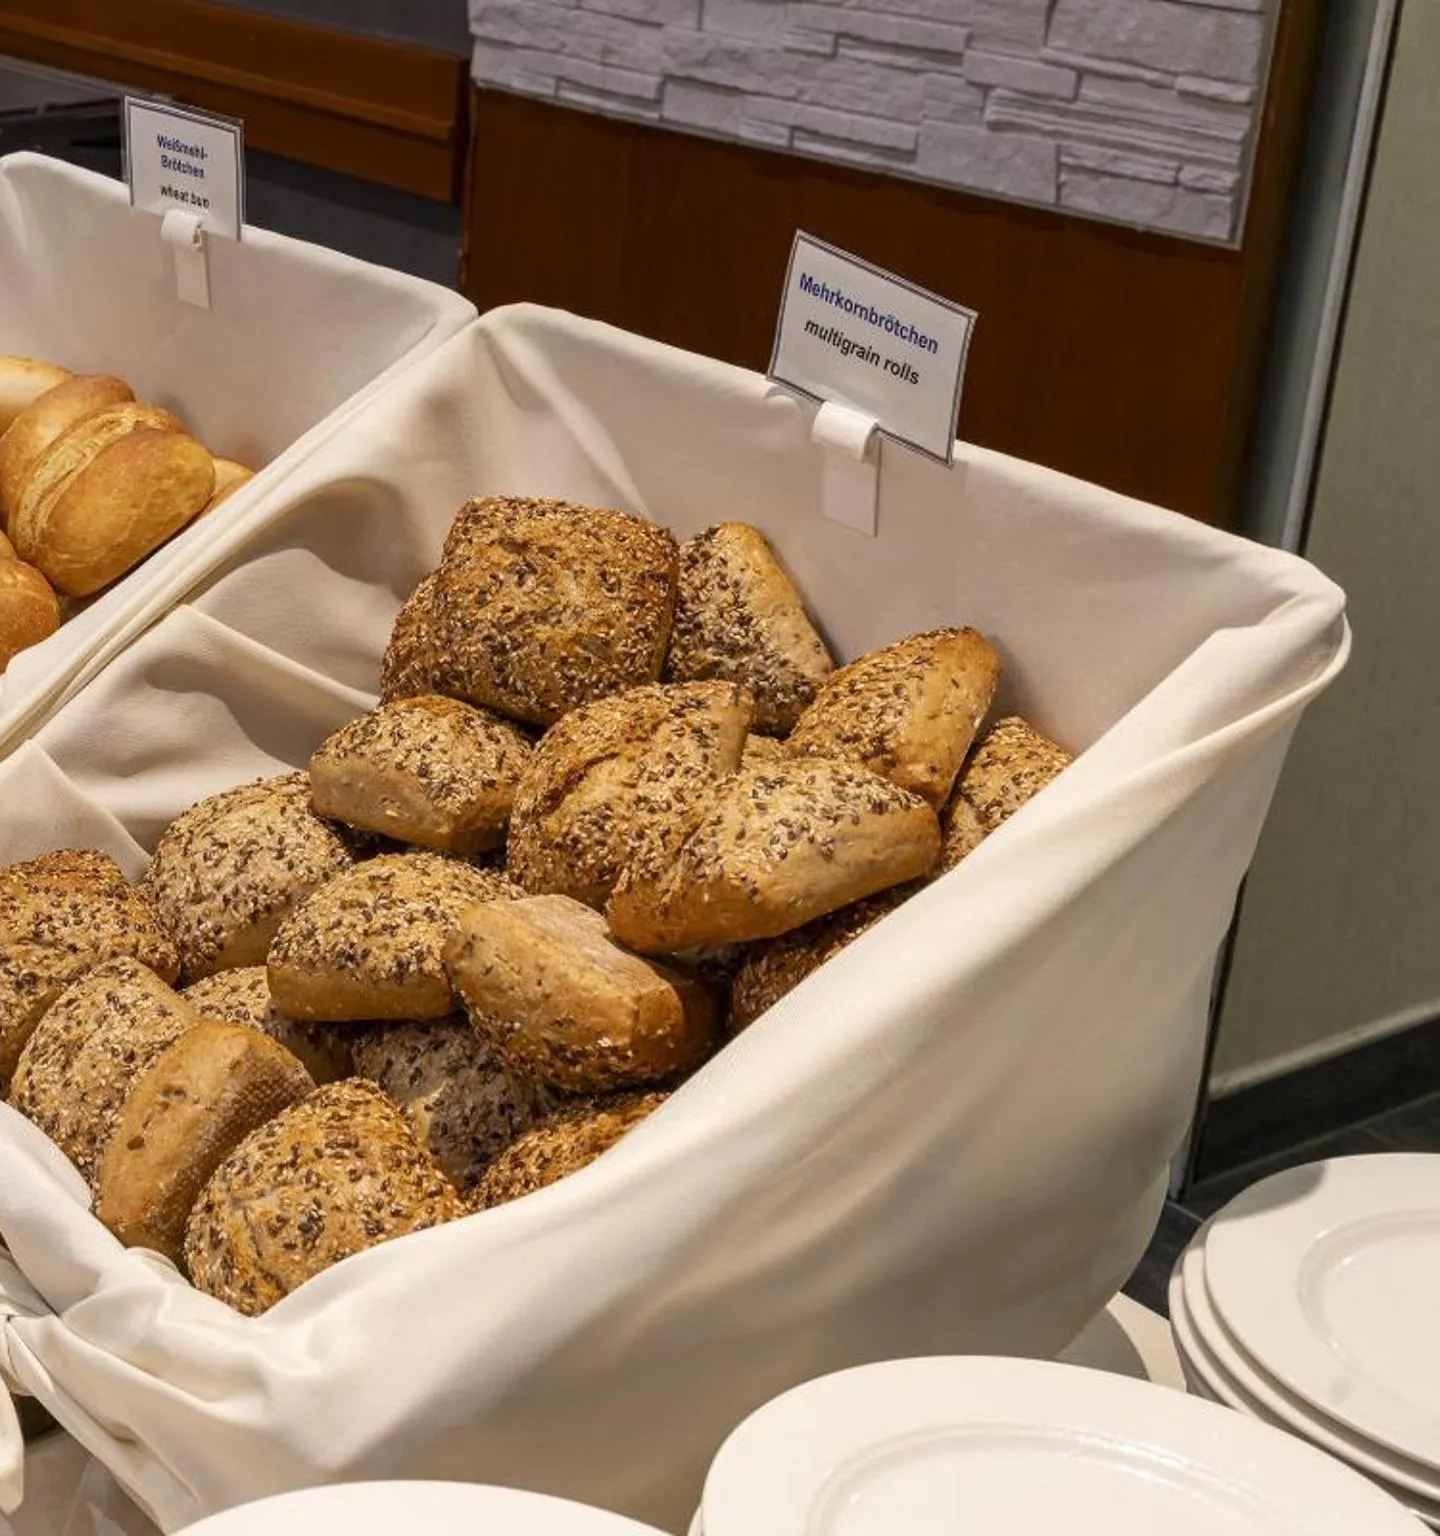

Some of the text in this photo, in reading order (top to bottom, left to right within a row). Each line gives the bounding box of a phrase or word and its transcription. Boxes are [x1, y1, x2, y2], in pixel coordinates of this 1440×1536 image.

[160, 184, 189, 203] wheat
[799, 272, 938, 354] Mehrkornbrötchen
[804, 318, 920, 385] multigrain rolls
